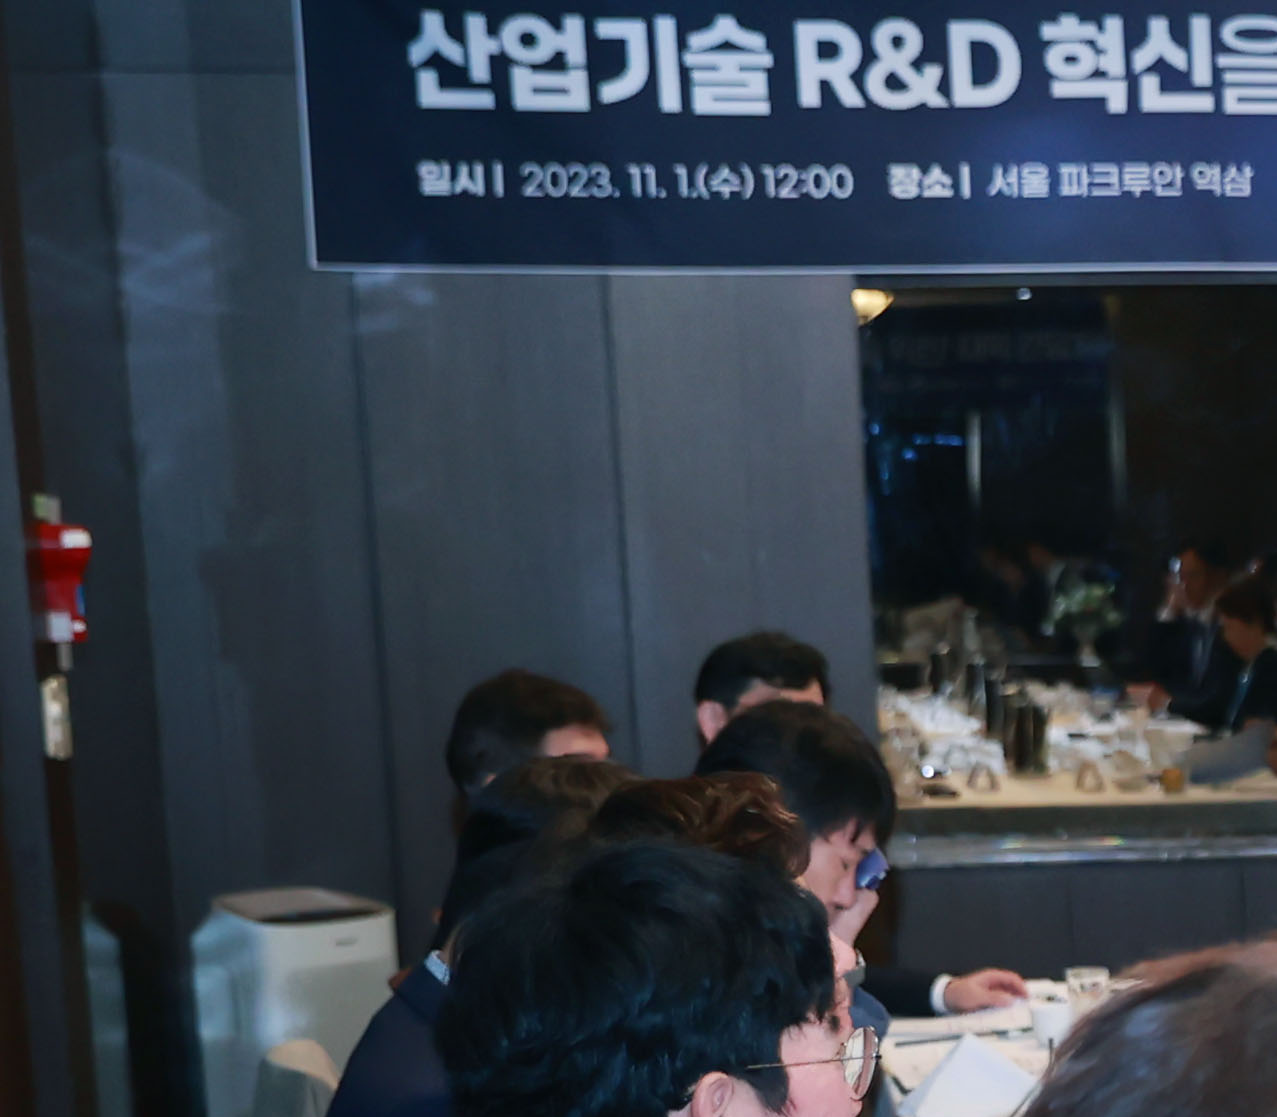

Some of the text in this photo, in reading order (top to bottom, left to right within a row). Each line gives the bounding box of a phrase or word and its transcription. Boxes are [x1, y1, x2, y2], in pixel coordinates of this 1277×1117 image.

[410, 12, 773, 115] 산업기술
[795, 19, 1021, 109] R&D
[419, 162, 484, 196] 일시
[762, 165, 853, 198] 12:00
[888, 164, 954, 199] 장소
[988, 162, 1051, 198] 서울
[1190, 162, 1254, 197] 역삼
